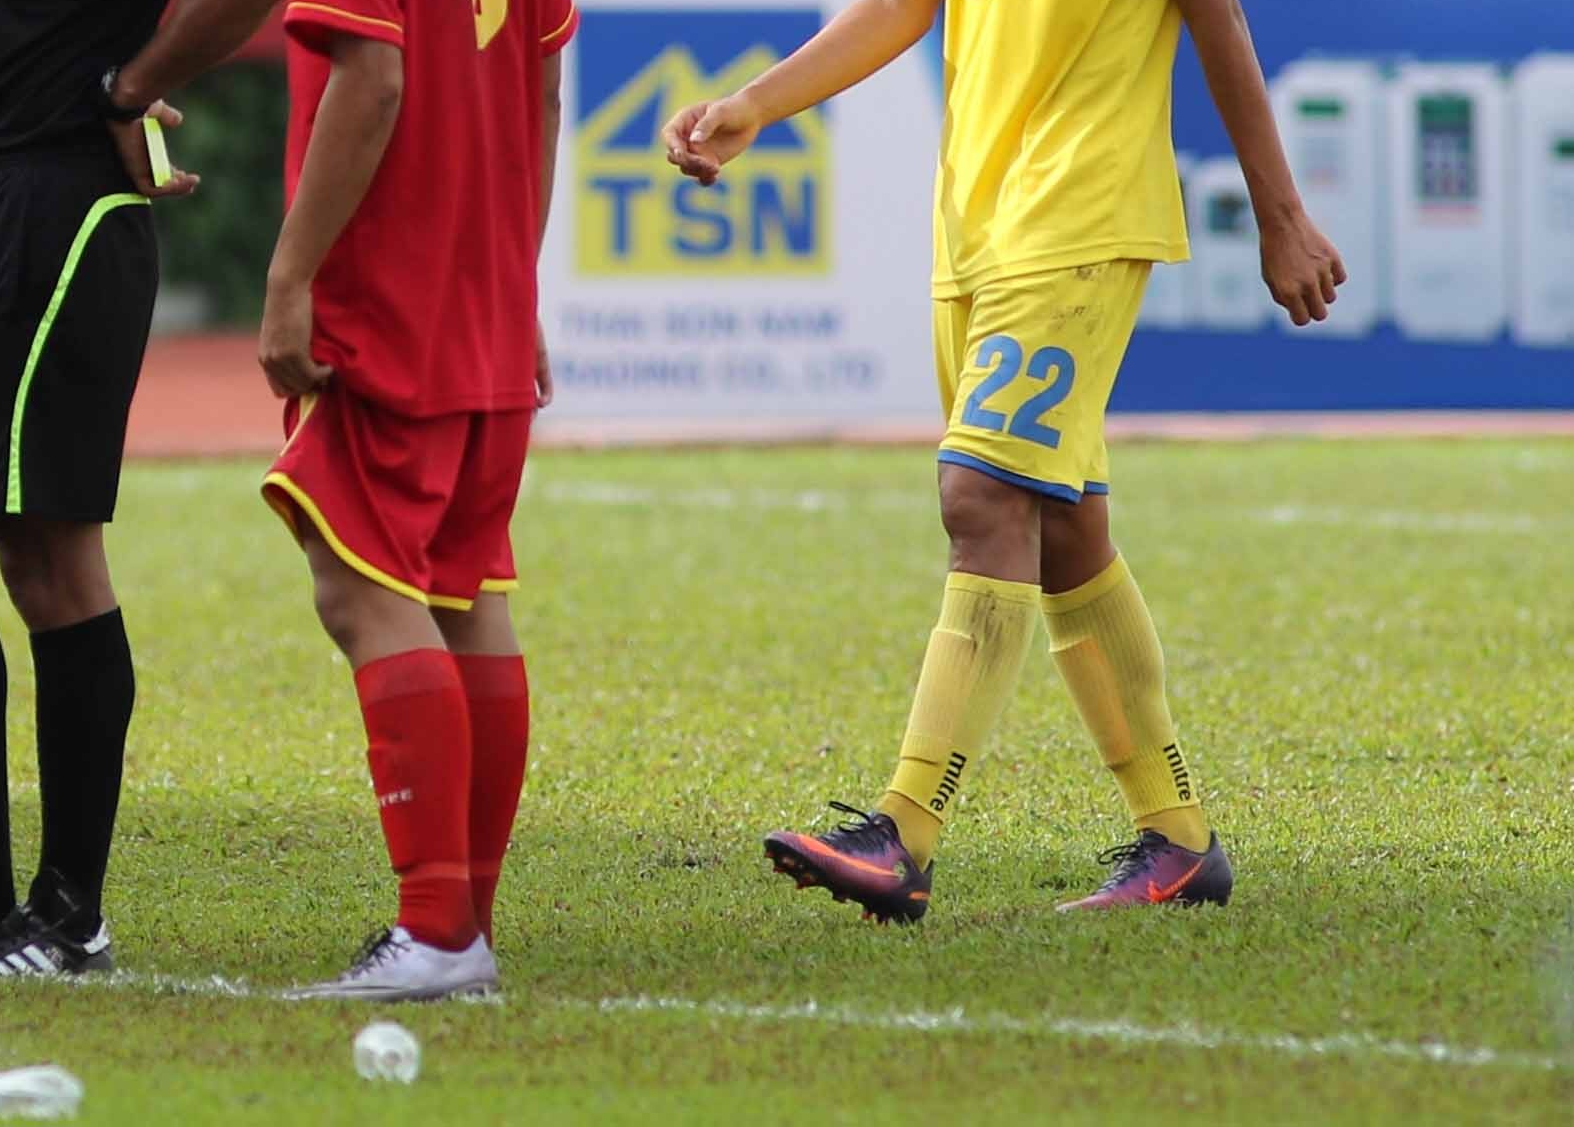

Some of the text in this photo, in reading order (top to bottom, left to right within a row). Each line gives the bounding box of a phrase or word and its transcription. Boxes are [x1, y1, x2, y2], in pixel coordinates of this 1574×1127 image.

[587, 176, 817, 259] TSN
[960, 334, 1076, 450] 22
[929, 752, 967, 811] mitre
[1163, 743, 1191, 802] mitre
